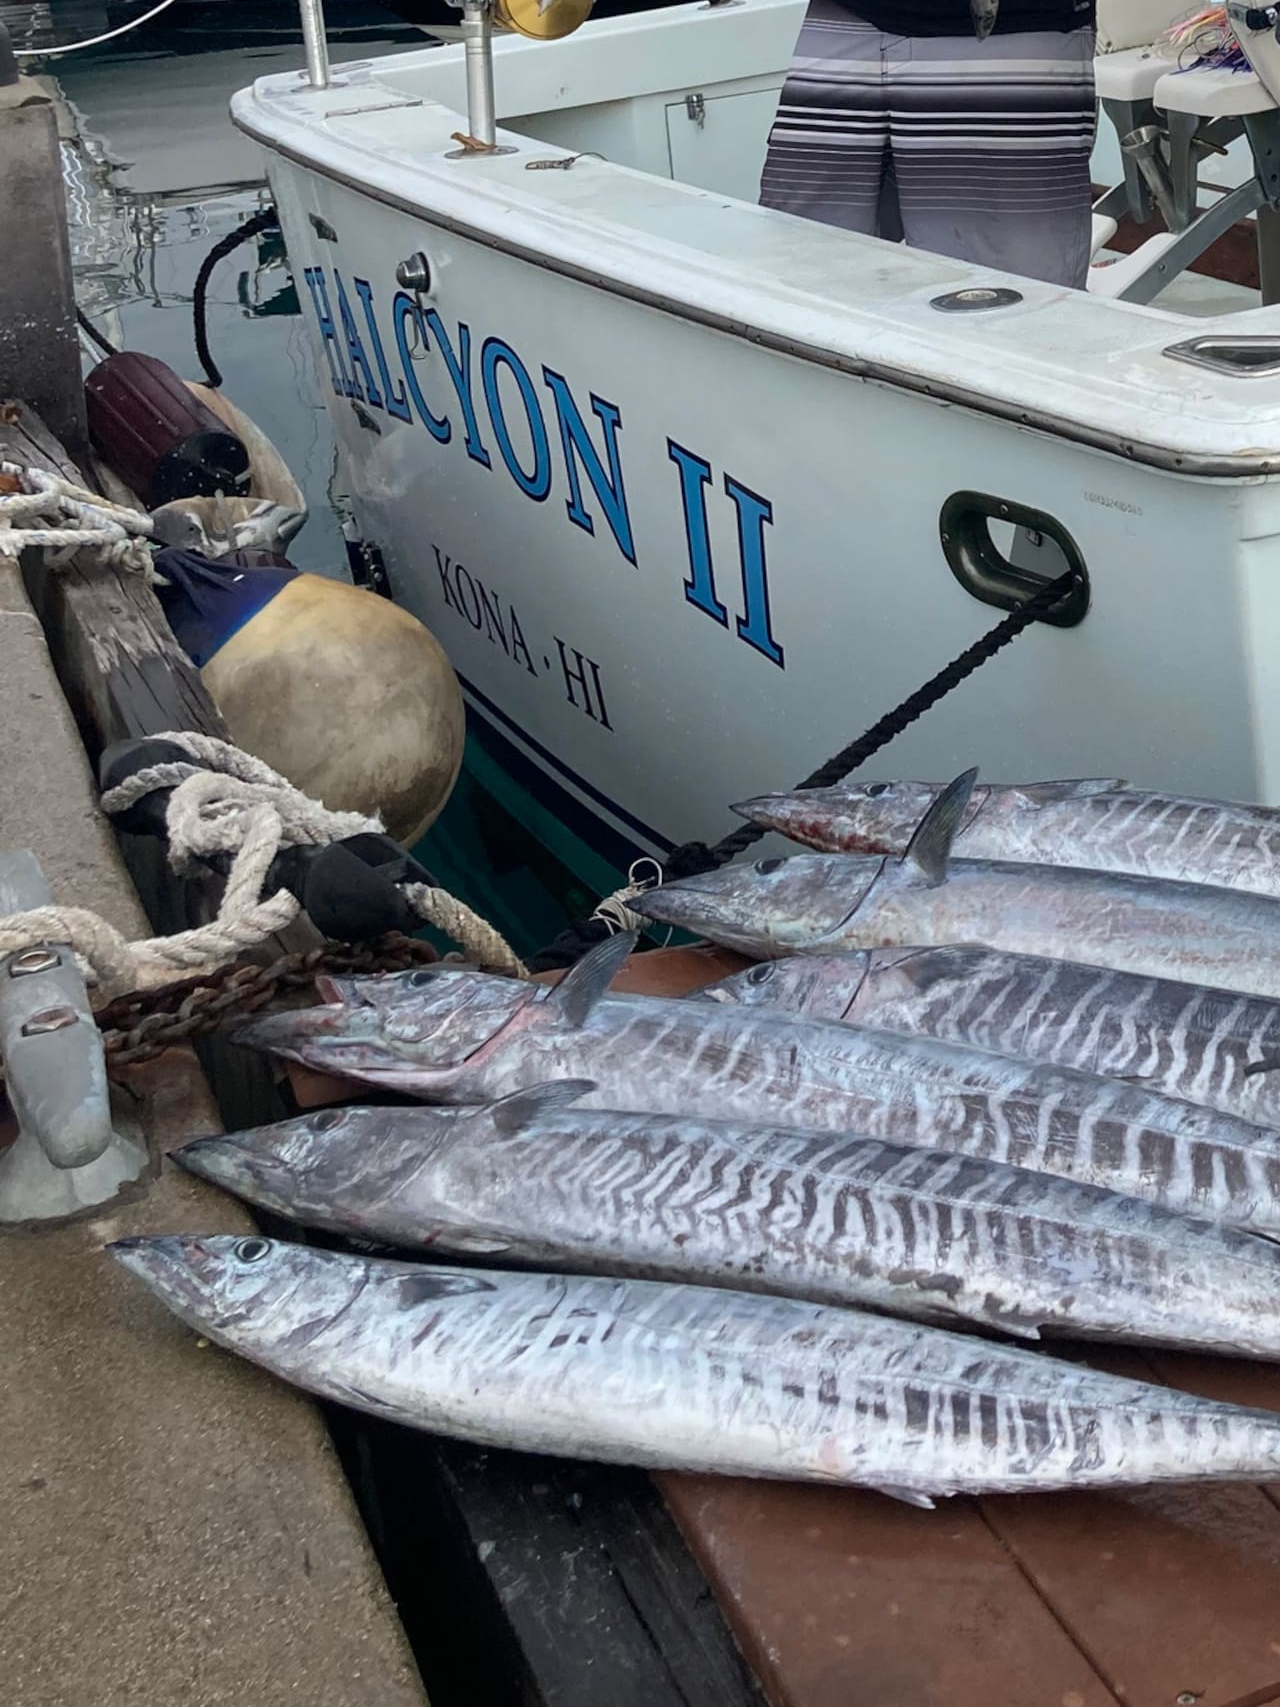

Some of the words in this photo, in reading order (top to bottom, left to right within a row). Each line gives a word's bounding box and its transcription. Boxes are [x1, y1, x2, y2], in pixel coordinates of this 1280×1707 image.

[303, 267, 638, 569] HALCYON
[666, 436, 785, 670] II
[431, 544, 538, 678] KONA
